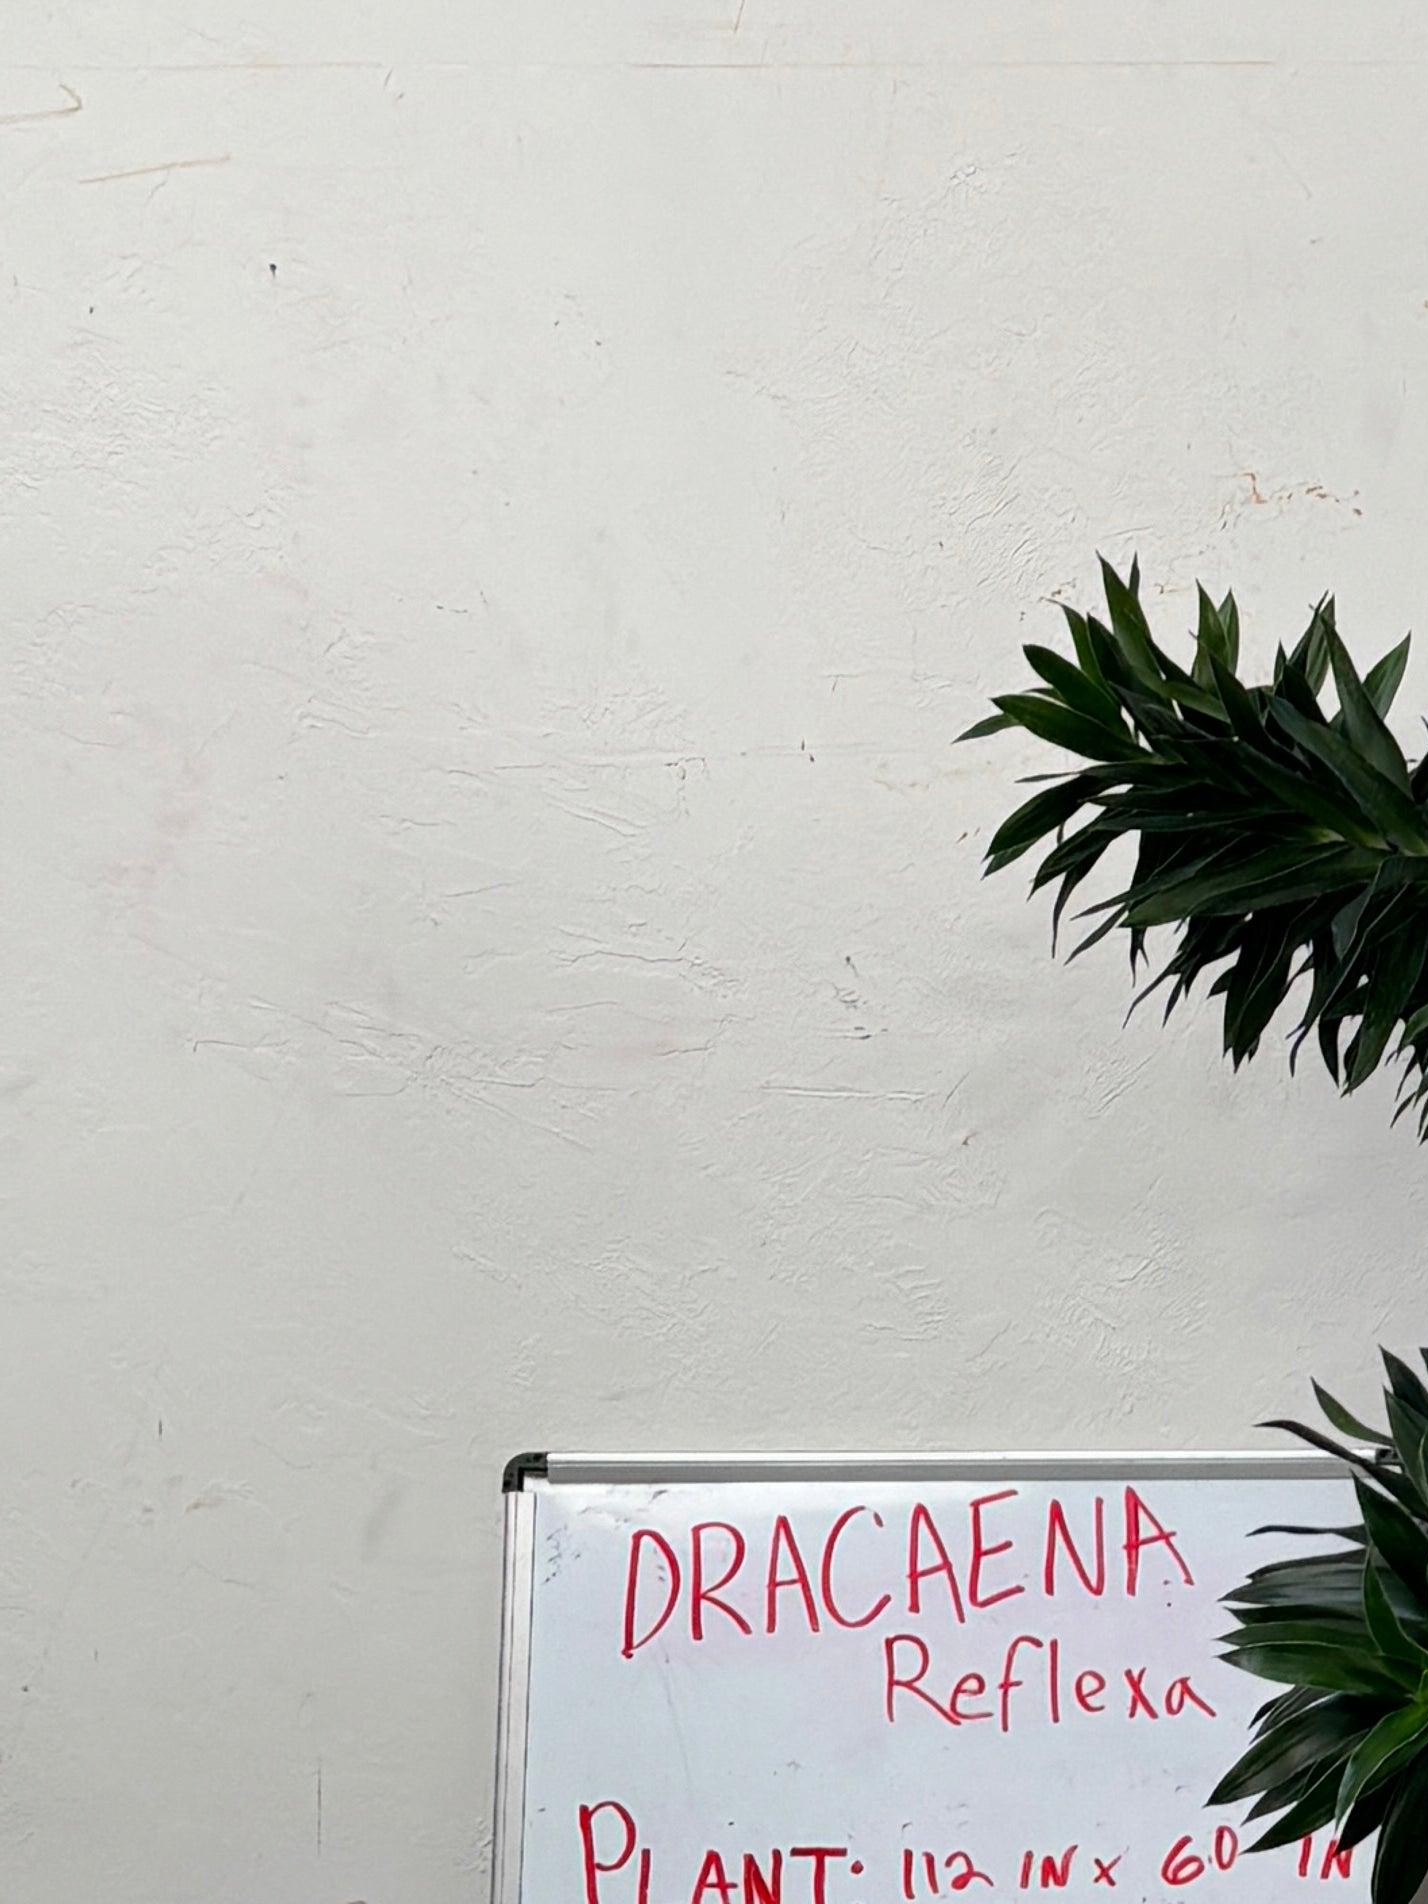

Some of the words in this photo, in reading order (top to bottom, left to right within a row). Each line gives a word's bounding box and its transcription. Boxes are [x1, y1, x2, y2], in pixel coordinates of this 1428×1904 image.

[621, 1486, 1194, 1660] DRACAENA
[884, 1634, 1216, 1732] Reflexa
[902, 1849, 993, 1901] 112
[1020, 1844, 1078, 1890] IN
[1160, 1825, 1239, 1886] 60
